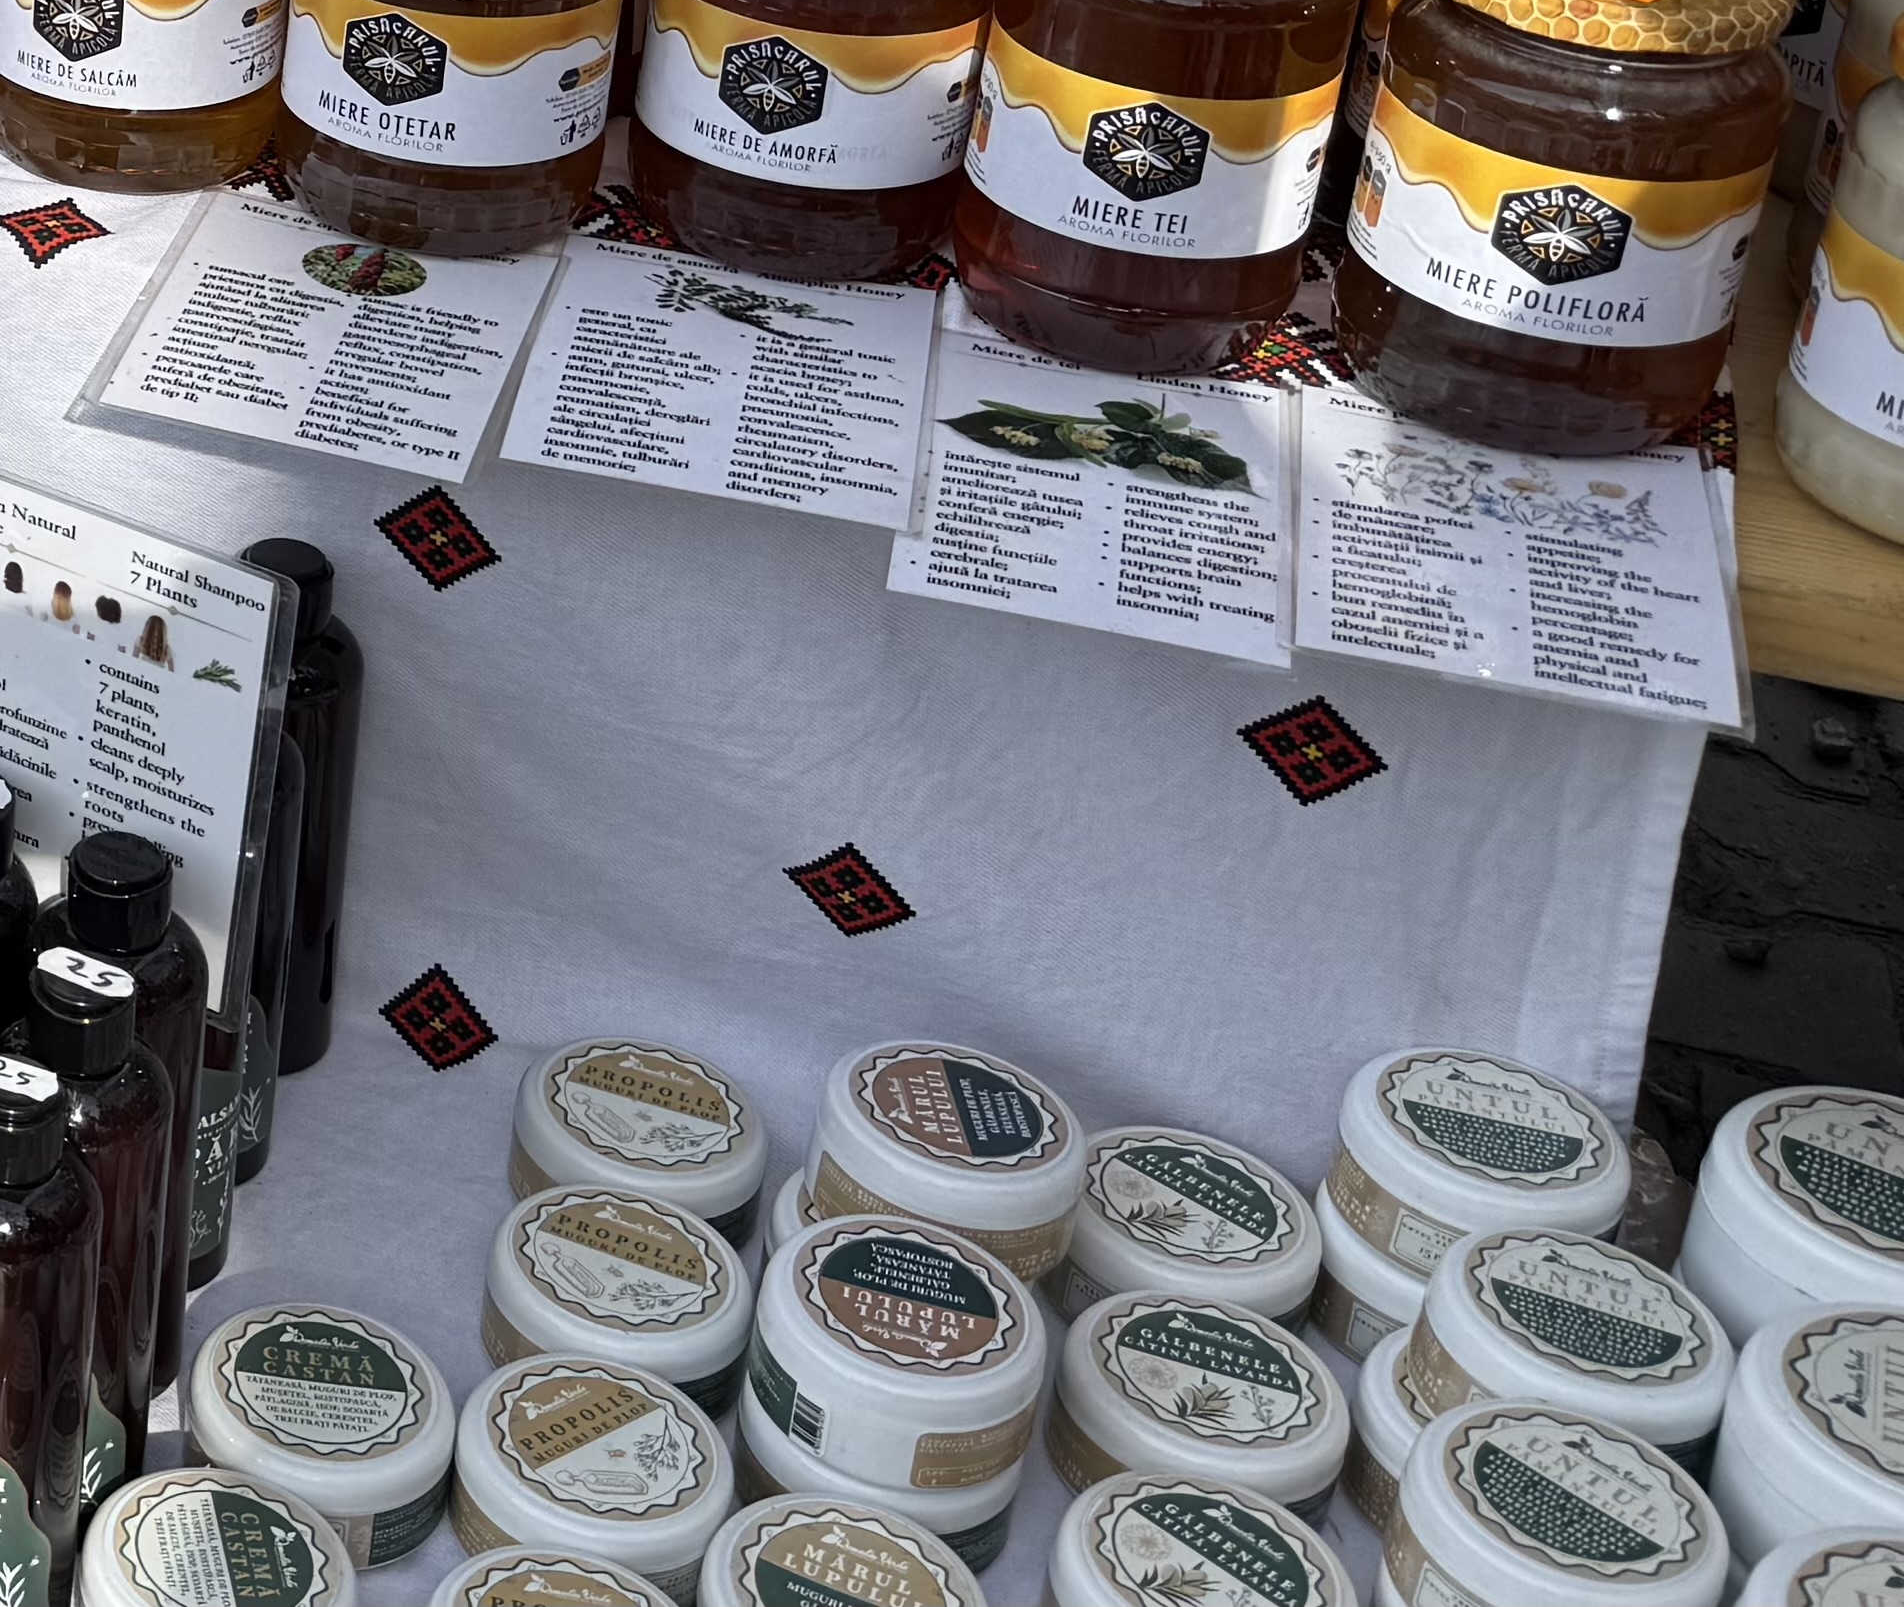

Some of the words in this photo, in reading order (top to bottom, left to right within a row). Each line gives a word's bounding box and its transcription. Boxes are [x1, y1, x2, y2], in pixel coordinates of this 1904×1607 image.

[348, 17, 442, 66] PRISACARUL
[16, 49, 52, 74] MIERE
[57, 60, 75, 78] DE
[318, 89, 369, 126] MIERE
[694, 118, 736, 146] MIERE
[743, 134, 761, 153] DE
[769, 141, 838, 164] AMORFĂ
[1092, 107, 1202, 156] PRISACARUL
[1058, 215, 1115, 238] AROMA
[1122, 230, 1196, 248] FLORILOR
[1072, 195, 1144, 229] MIERE
[1155, 212, 1188, 234] TEI
[1501, 188, 1624, 241] PRISACARUL
[1426, 257, 1497, 299] MIERE
[1507, 285, 1649, 322] POLIFLORĂ
[1461, 298, 1526, 323] AROMA
[1533, 316, 1614, 336] FLORILOR
[971, 343, 1025, 361] Miere
[1031, 355, 1053, 366] de
[1057, 359, 1081, 370] tei
[743, 392, 818, 418] bronchial
[820, 405, 899, 428] infections,
[11, 502, 77, 541] Natural
[1121, 531, 1194, 553] provides
[1197, 543, 1258, 566] energy;
[130, 549, 190, 583] Natural
[193, 574, 267, 613] Shampoo
[130, 570, 141, 585] 7
[145, 576, 198, 610] Plants
[1598, 575, 1616, 590] of
[1619, 578, 1649, 596] the
[1652, 586, 1701, 605] heart
[99, 662, 161, 695] contains
[91, 717, 166, 756] panthenol
[95, 699, 157, 737] keratin,
[83, 798, 125, 825] roots
[86, 778, 175, 826] strengthens
[179, 817, 205, 839] the
[584, 1063, 721, 1113] PROPOLIS
[1424, 1080, 1561, 1122] UNTUL
[263, 1346, 375, 1373] CREMĂ
[1139, 1327, 1281, 1376] GĂLBENELE
[263, 1361, 375, 1385] CASTAN
[518, 1387, 635, 1452] PROPOLIS
